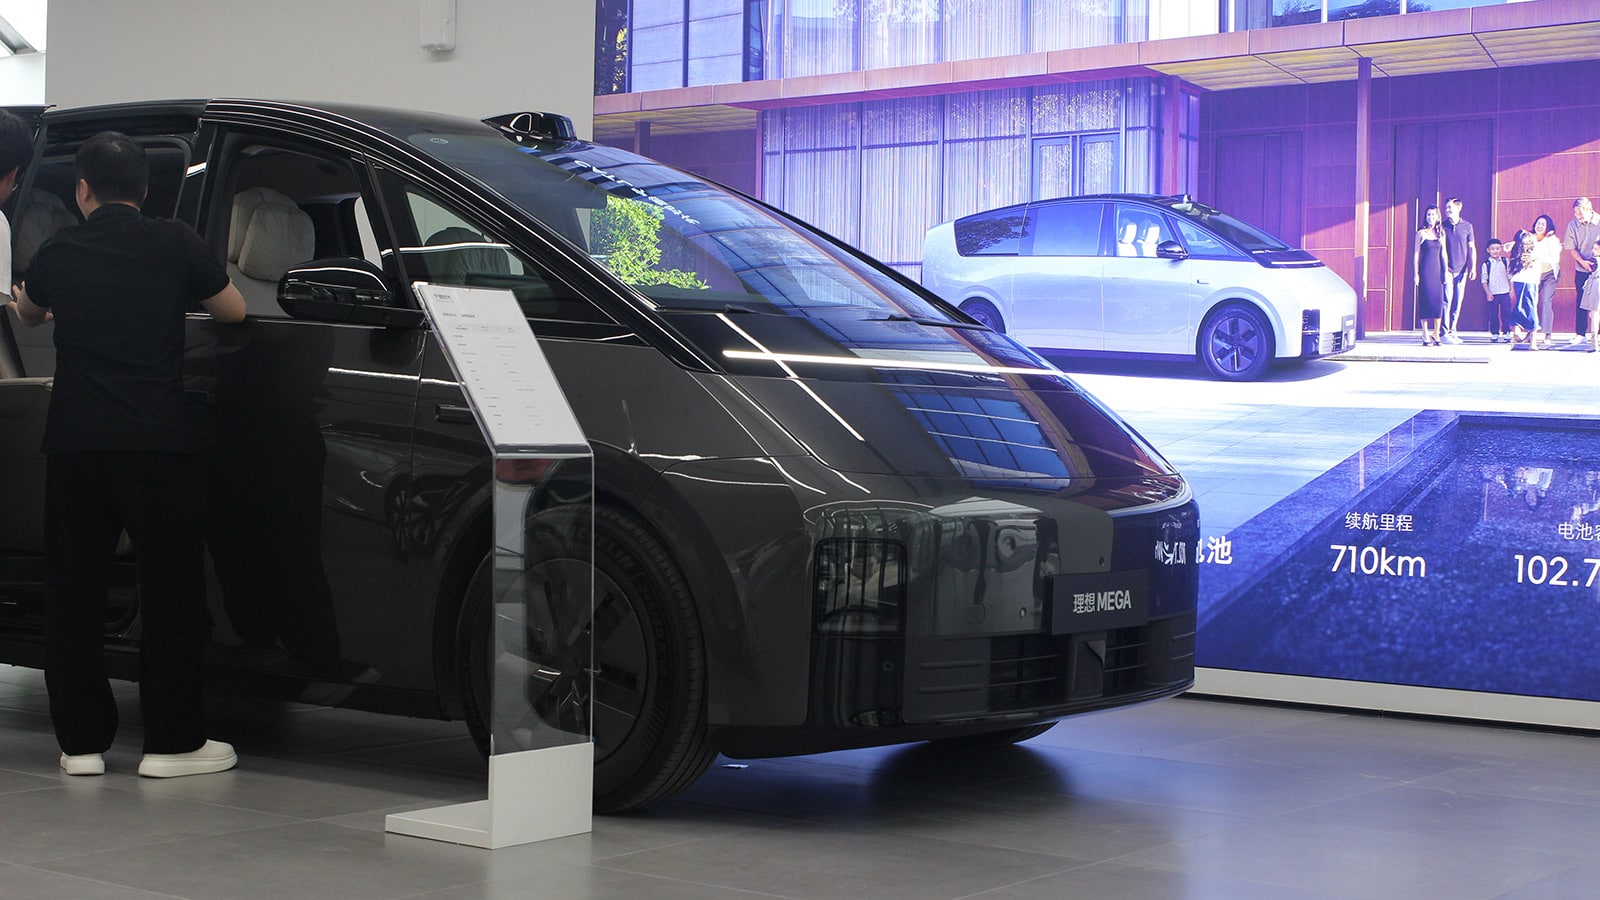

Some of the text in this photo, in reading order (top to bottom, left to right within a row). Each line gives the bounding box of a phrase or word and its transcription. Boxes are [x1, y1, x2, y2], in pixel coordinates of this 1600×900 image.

[1344, 511, 1414, 532] 续航里程
[1330, 544, 1426, 578] 710km
[1514, 553, 1600, 588] 102.7
[1073, 589, 1132, 614] 理想 MEGA
